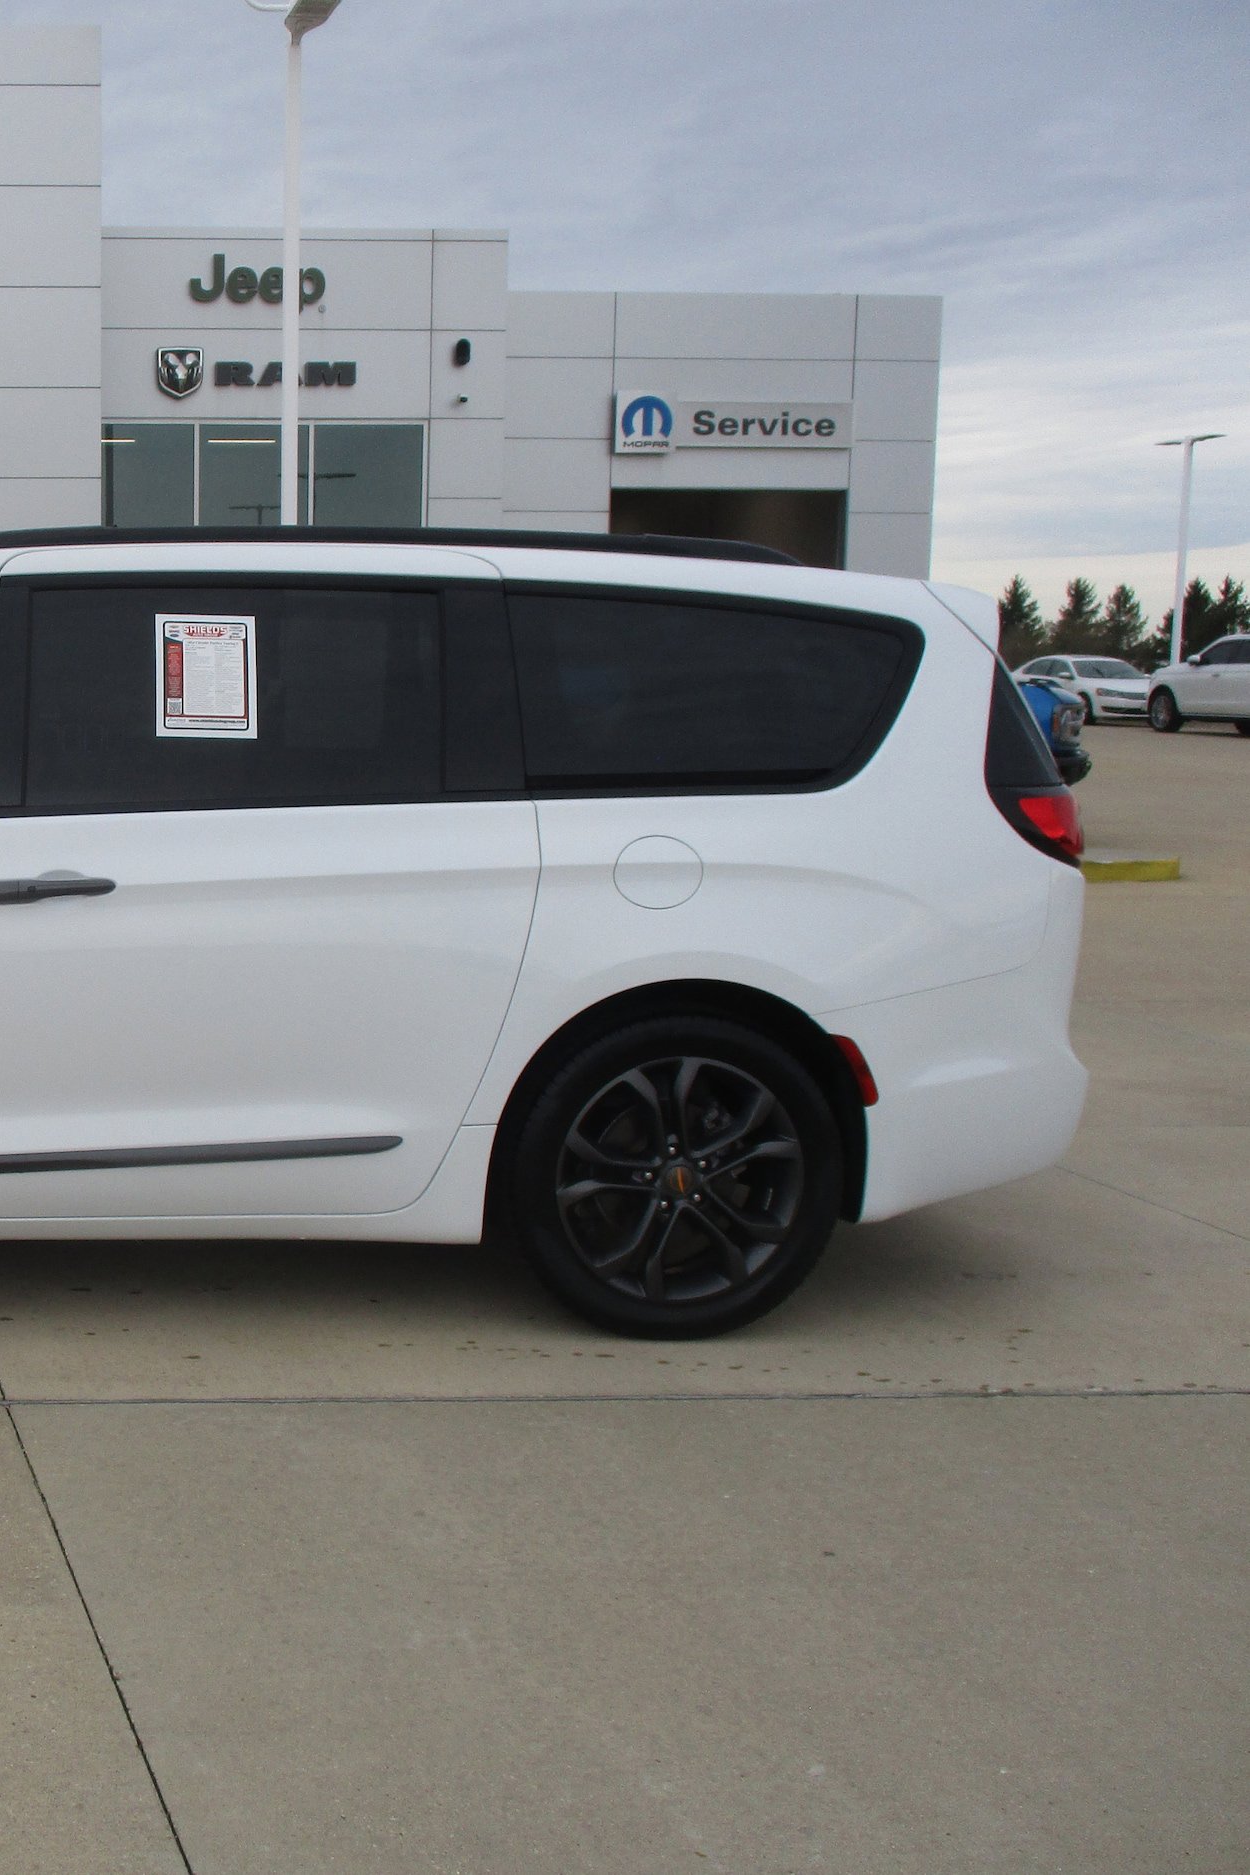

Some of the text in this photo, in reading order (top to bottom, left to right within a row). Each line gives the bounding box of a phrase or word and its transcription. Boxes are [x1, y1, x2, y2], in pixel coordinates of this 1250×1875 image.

[190, 254, 326, 314] Jeep
[692, 410, 837, 437] Service
[622, 440, 670, 448] MOPAR
[183, 625, 227, 634] SHIELDS
